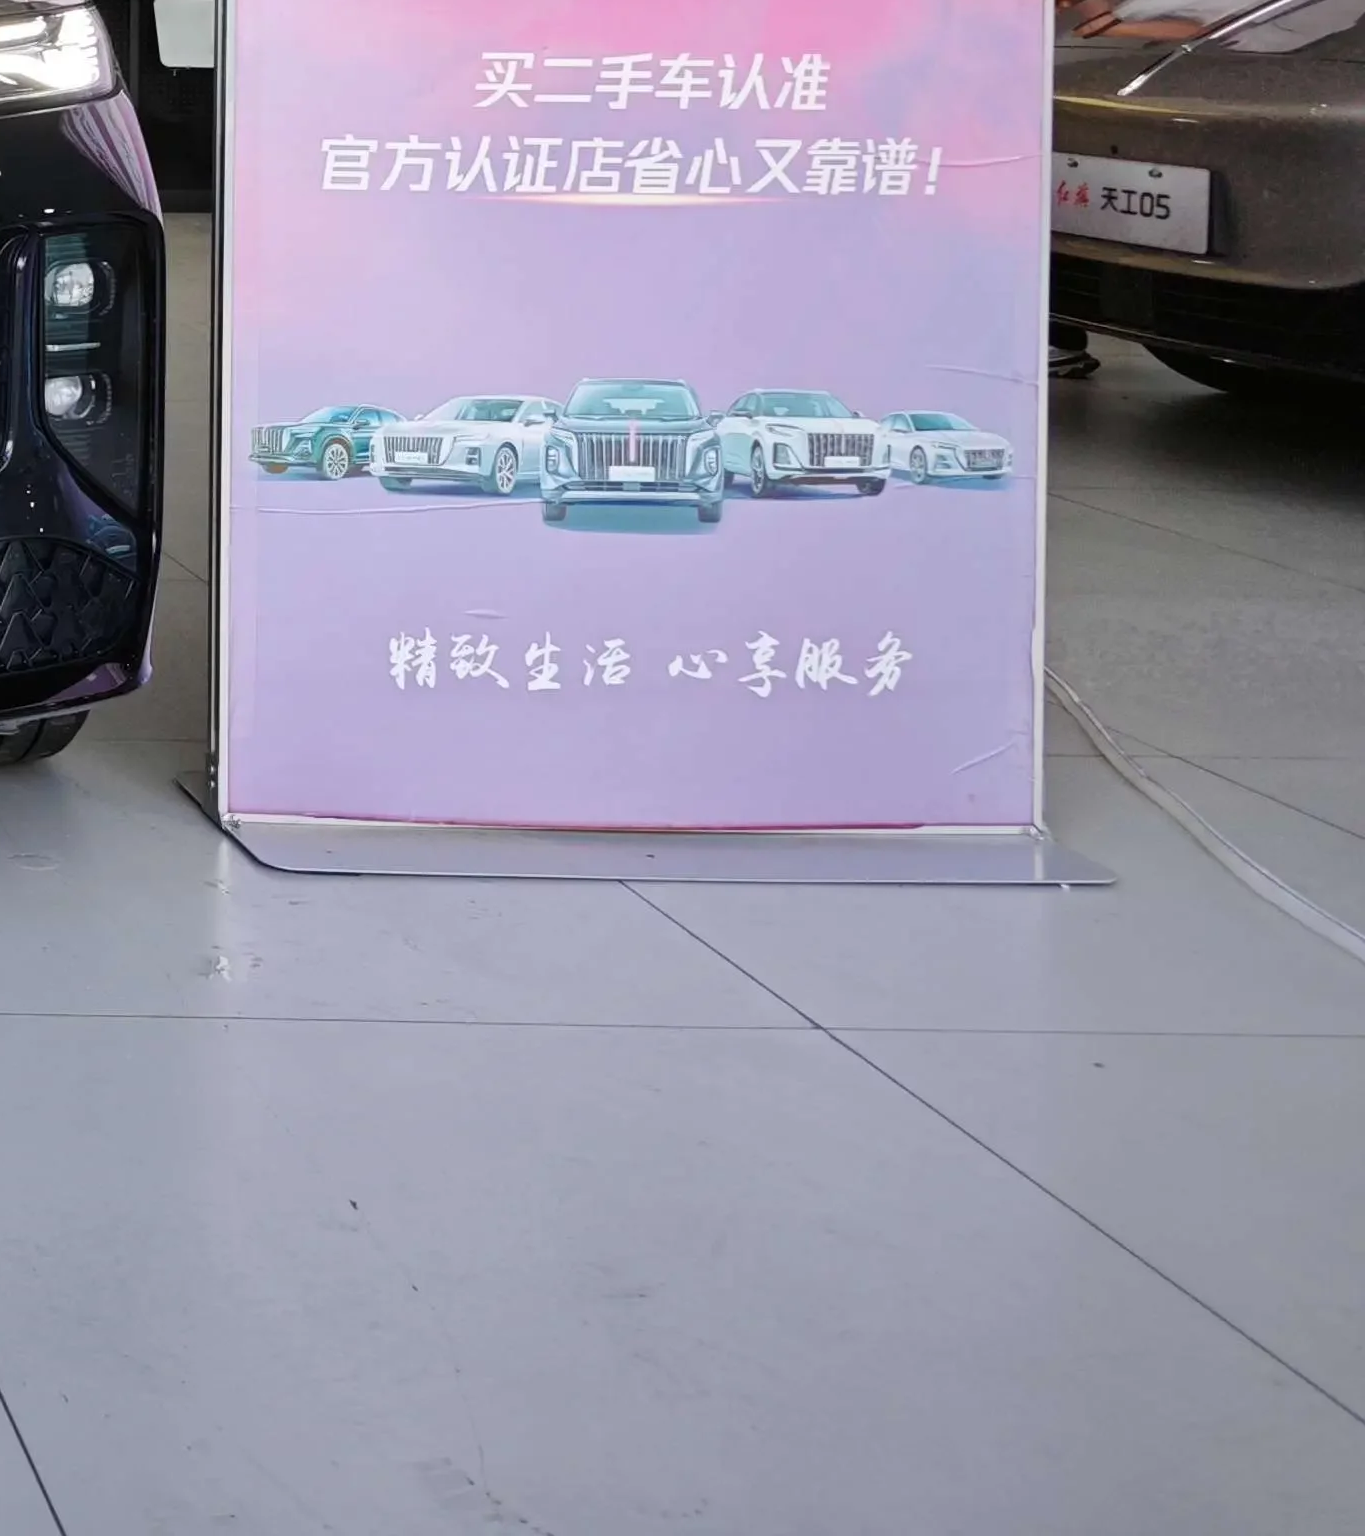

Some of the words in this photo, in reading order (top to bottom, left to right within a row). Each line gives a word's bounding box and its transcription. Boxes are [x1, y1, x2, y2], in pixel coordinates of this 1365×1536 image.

[473, 52, 831, 112] 买二手车认准
[319, 134, 943, 197] 官方认证店省心又靠谱！
[1100, 186, 1172, 220] 天工05
[388, 627, 632, 692] 精致生活
[667, 630, 915, 697] 心享服务
